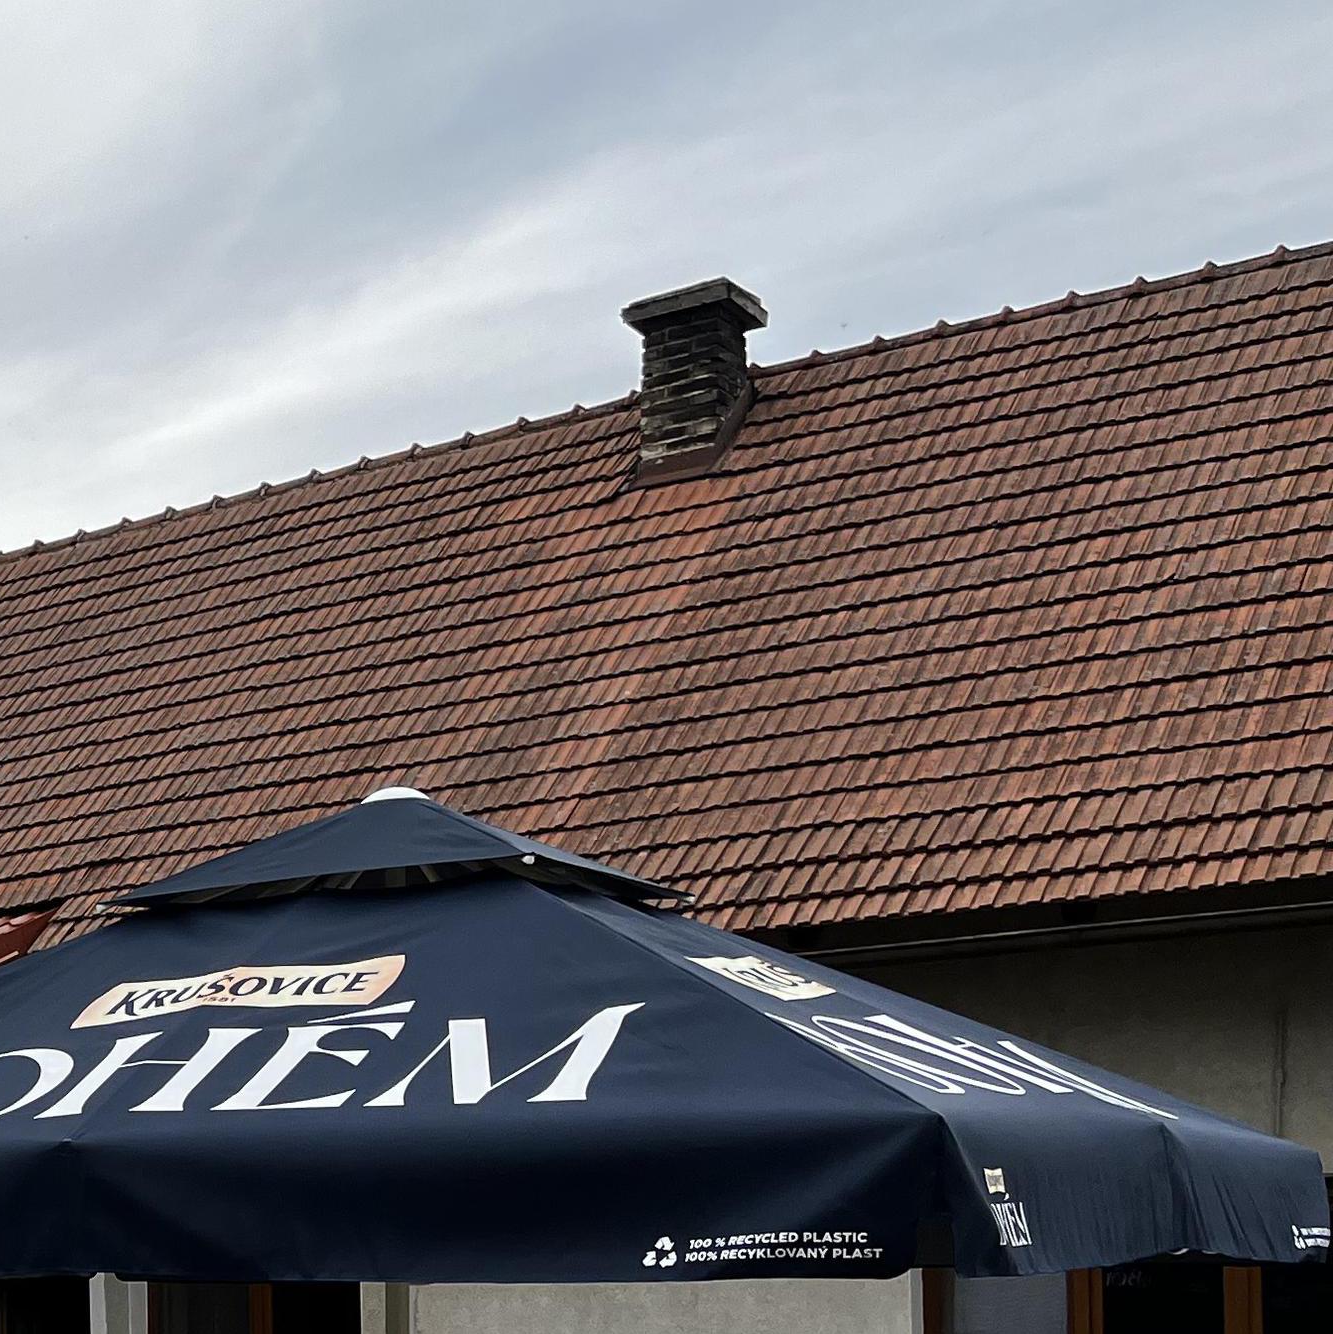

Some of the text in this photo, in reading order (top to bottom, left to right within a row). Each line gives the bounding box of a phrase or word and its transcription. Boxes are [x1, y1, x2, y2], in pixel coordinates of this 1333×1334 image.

[105, 971, 380, 1017] KRUŠOVICE
[689, 1231, 868, 1250] 100 % RECYCLED PLASTIC
[685, 1245, 883, 1263] 100% RECYKLOVANÝ PLAST
